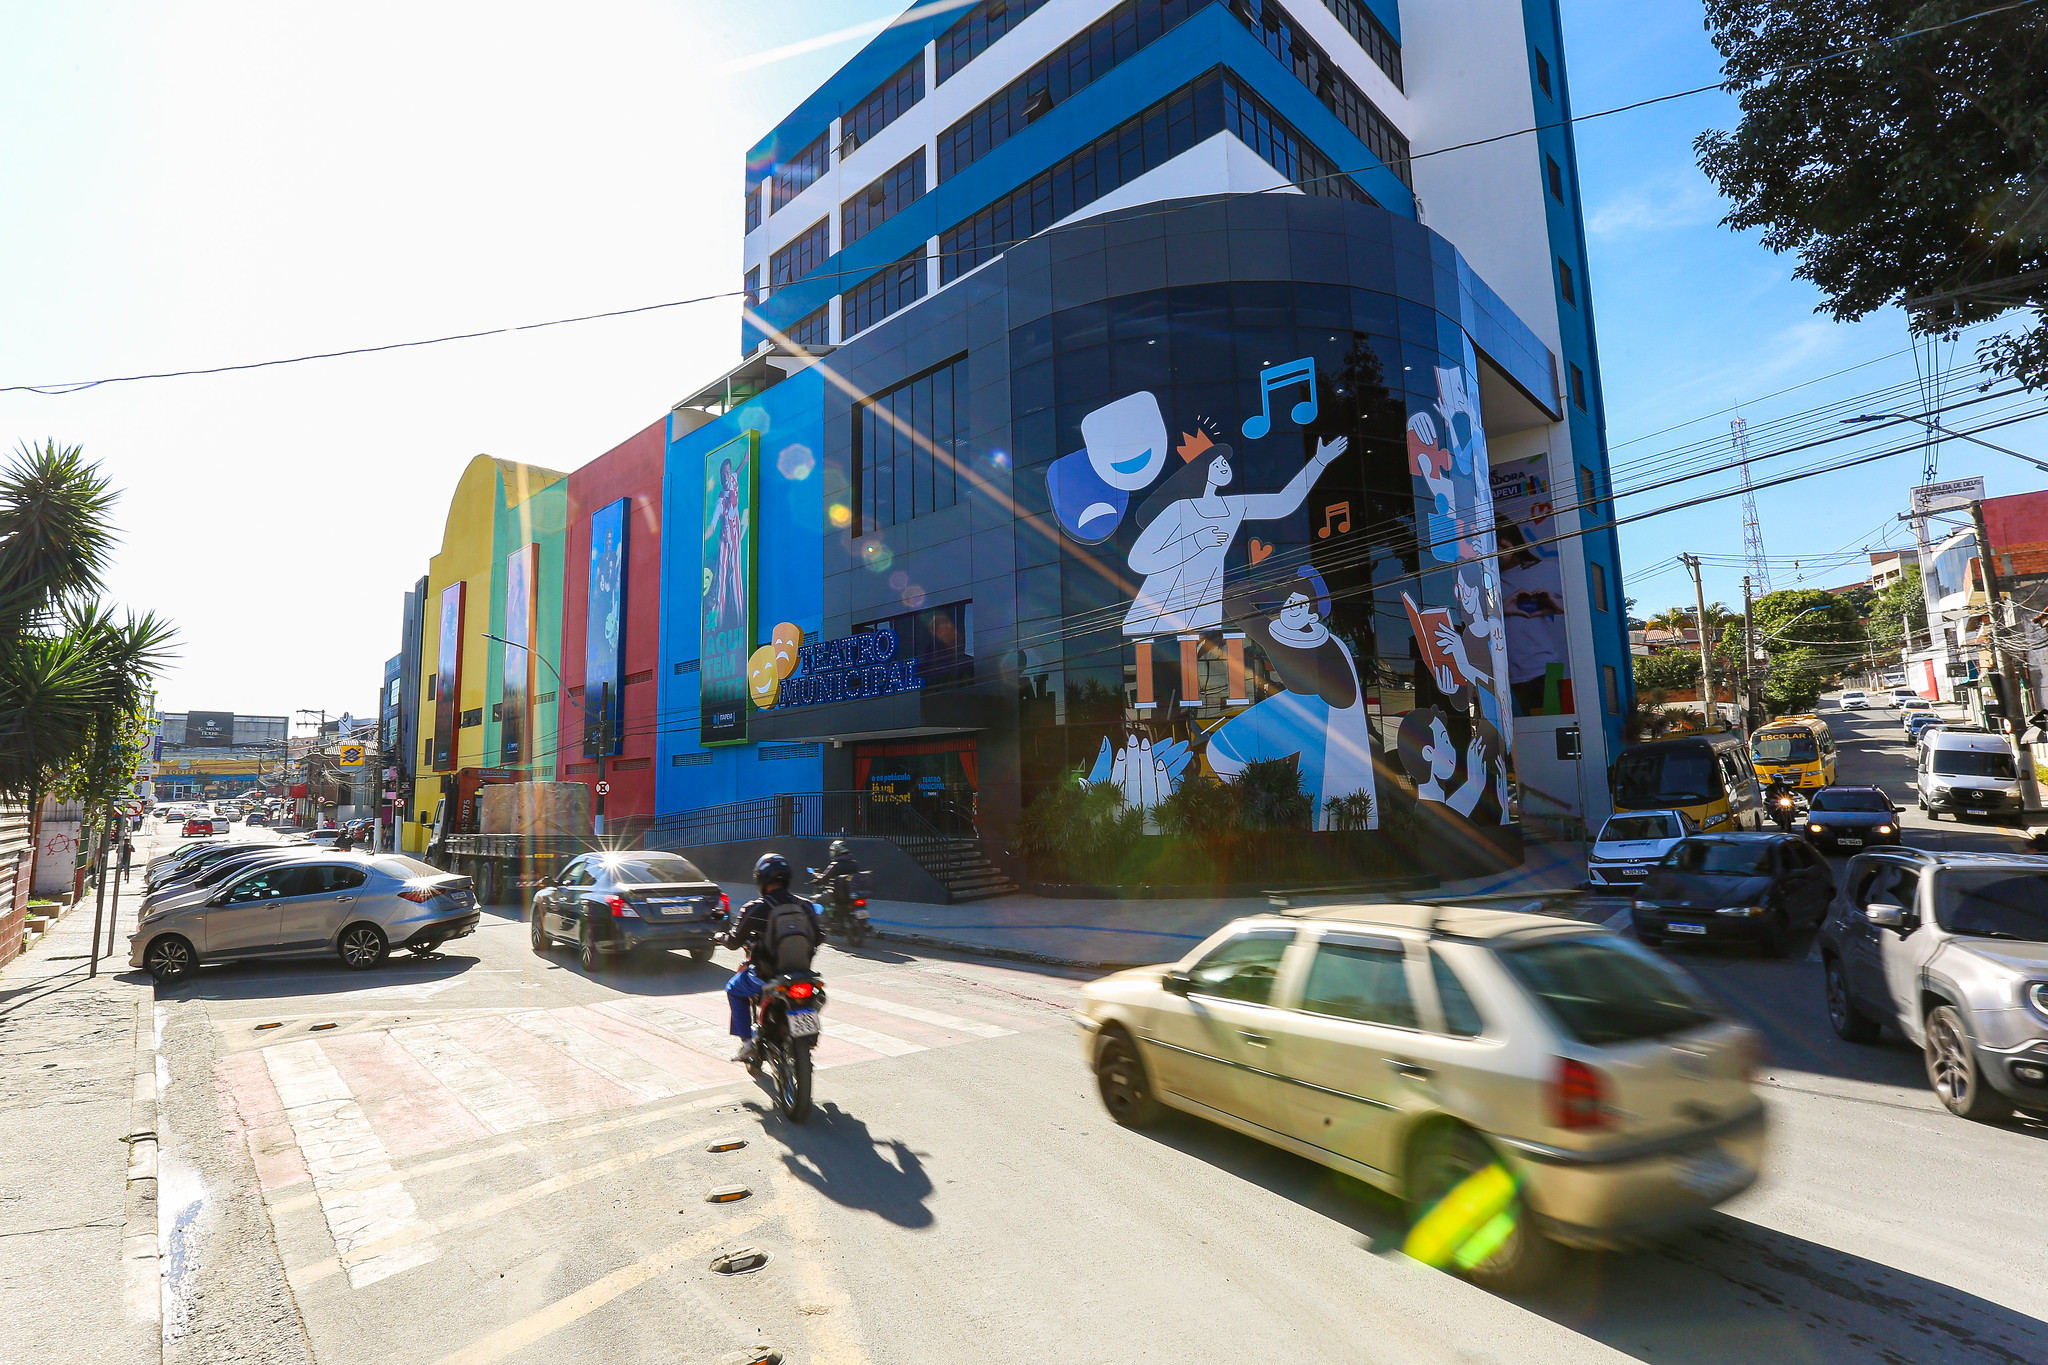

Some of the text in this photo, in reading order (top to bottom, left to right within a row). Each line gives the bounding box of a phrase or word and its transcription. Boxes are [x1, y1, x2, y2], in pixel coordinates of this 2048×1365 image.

[705, 627, 744, 657] AQUI
[799, 628, 898, 674] TEATRO
[703, 653, 736, 680] TEM
[705, 677, 744, 702] ARTE
[779, 657, 926, 709] MUNICIPAL
[1760, 733, 1806, 741] ESCOLAR
[876, 772, 911, 783] espetáculo
